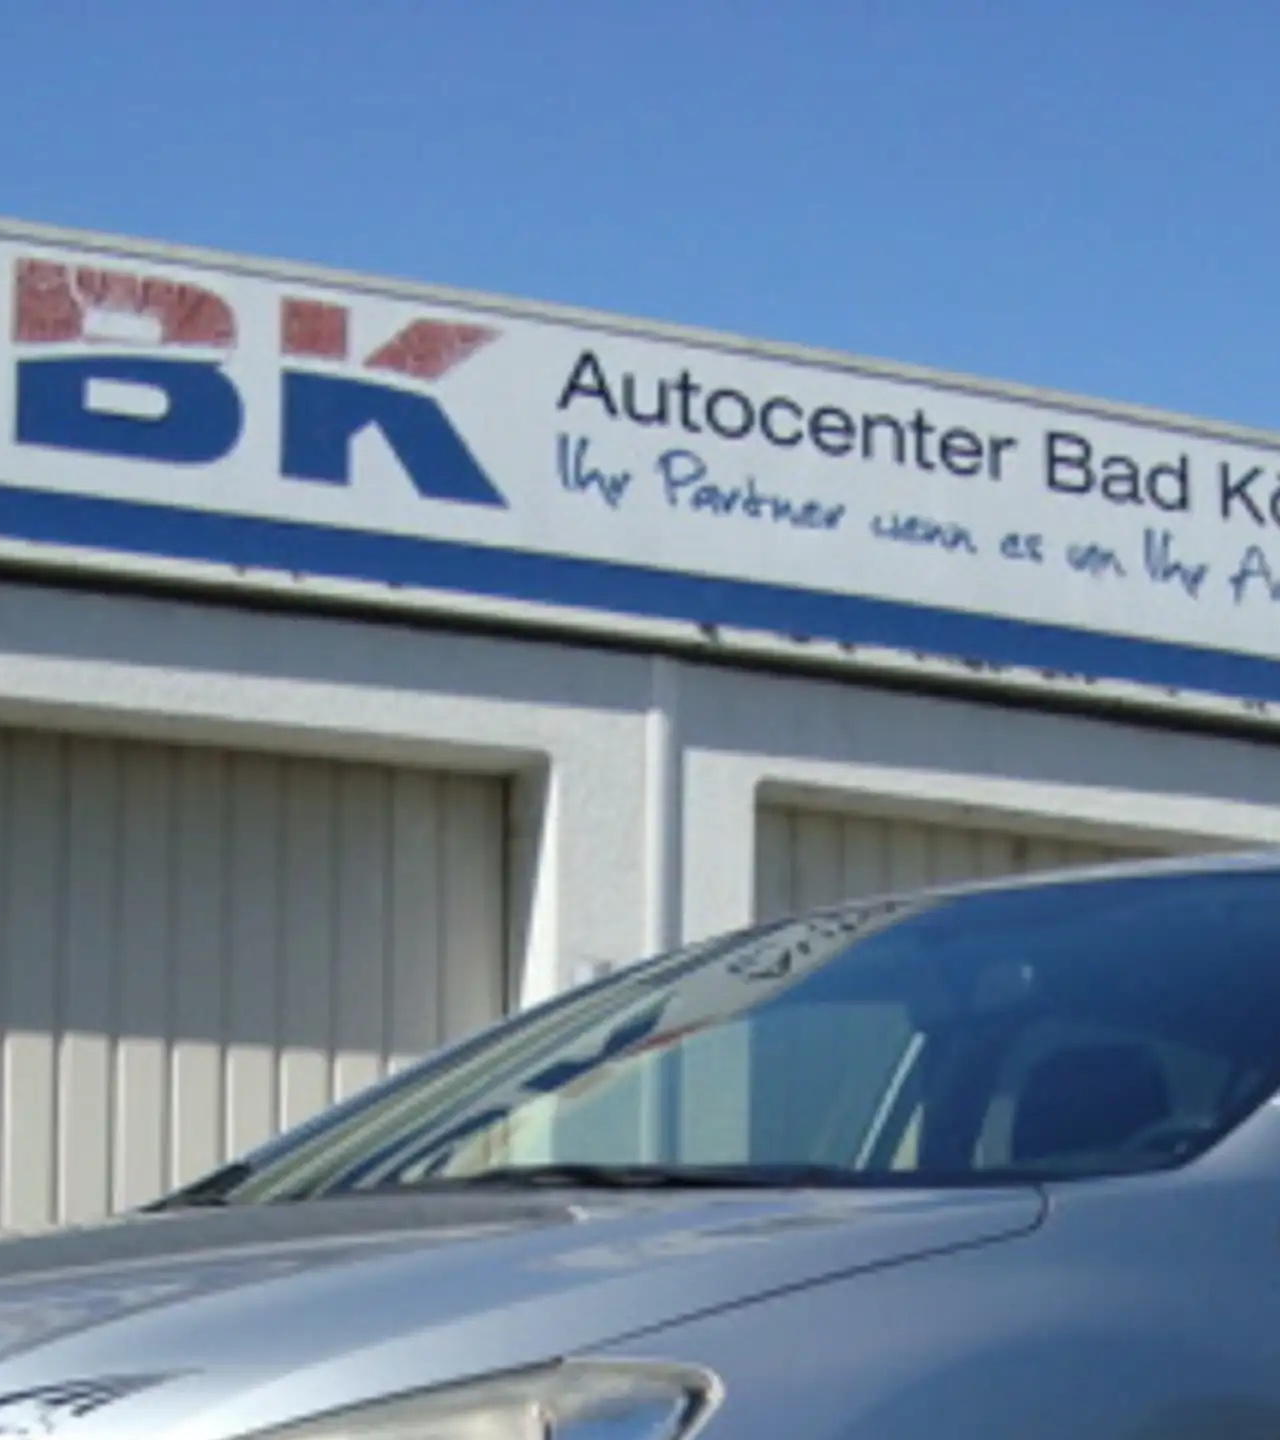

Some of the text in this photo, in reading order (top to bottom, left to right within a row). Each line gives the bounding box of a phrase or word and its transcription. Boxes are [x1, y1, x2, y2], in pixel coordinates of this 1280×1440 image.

[556, 348, 1018, 482] Autocenter
[1044, 430, 1190, 513] Bad
[556, 431, 632, 509] Ihr
[656, 448, 847, 531] Partner
[870, 511, 978, 555] wenn
[1000, 531, 1045, 564] es
[1067, 541, 1126, 578] um
[1143, 526, 1209, 600] Ihr
